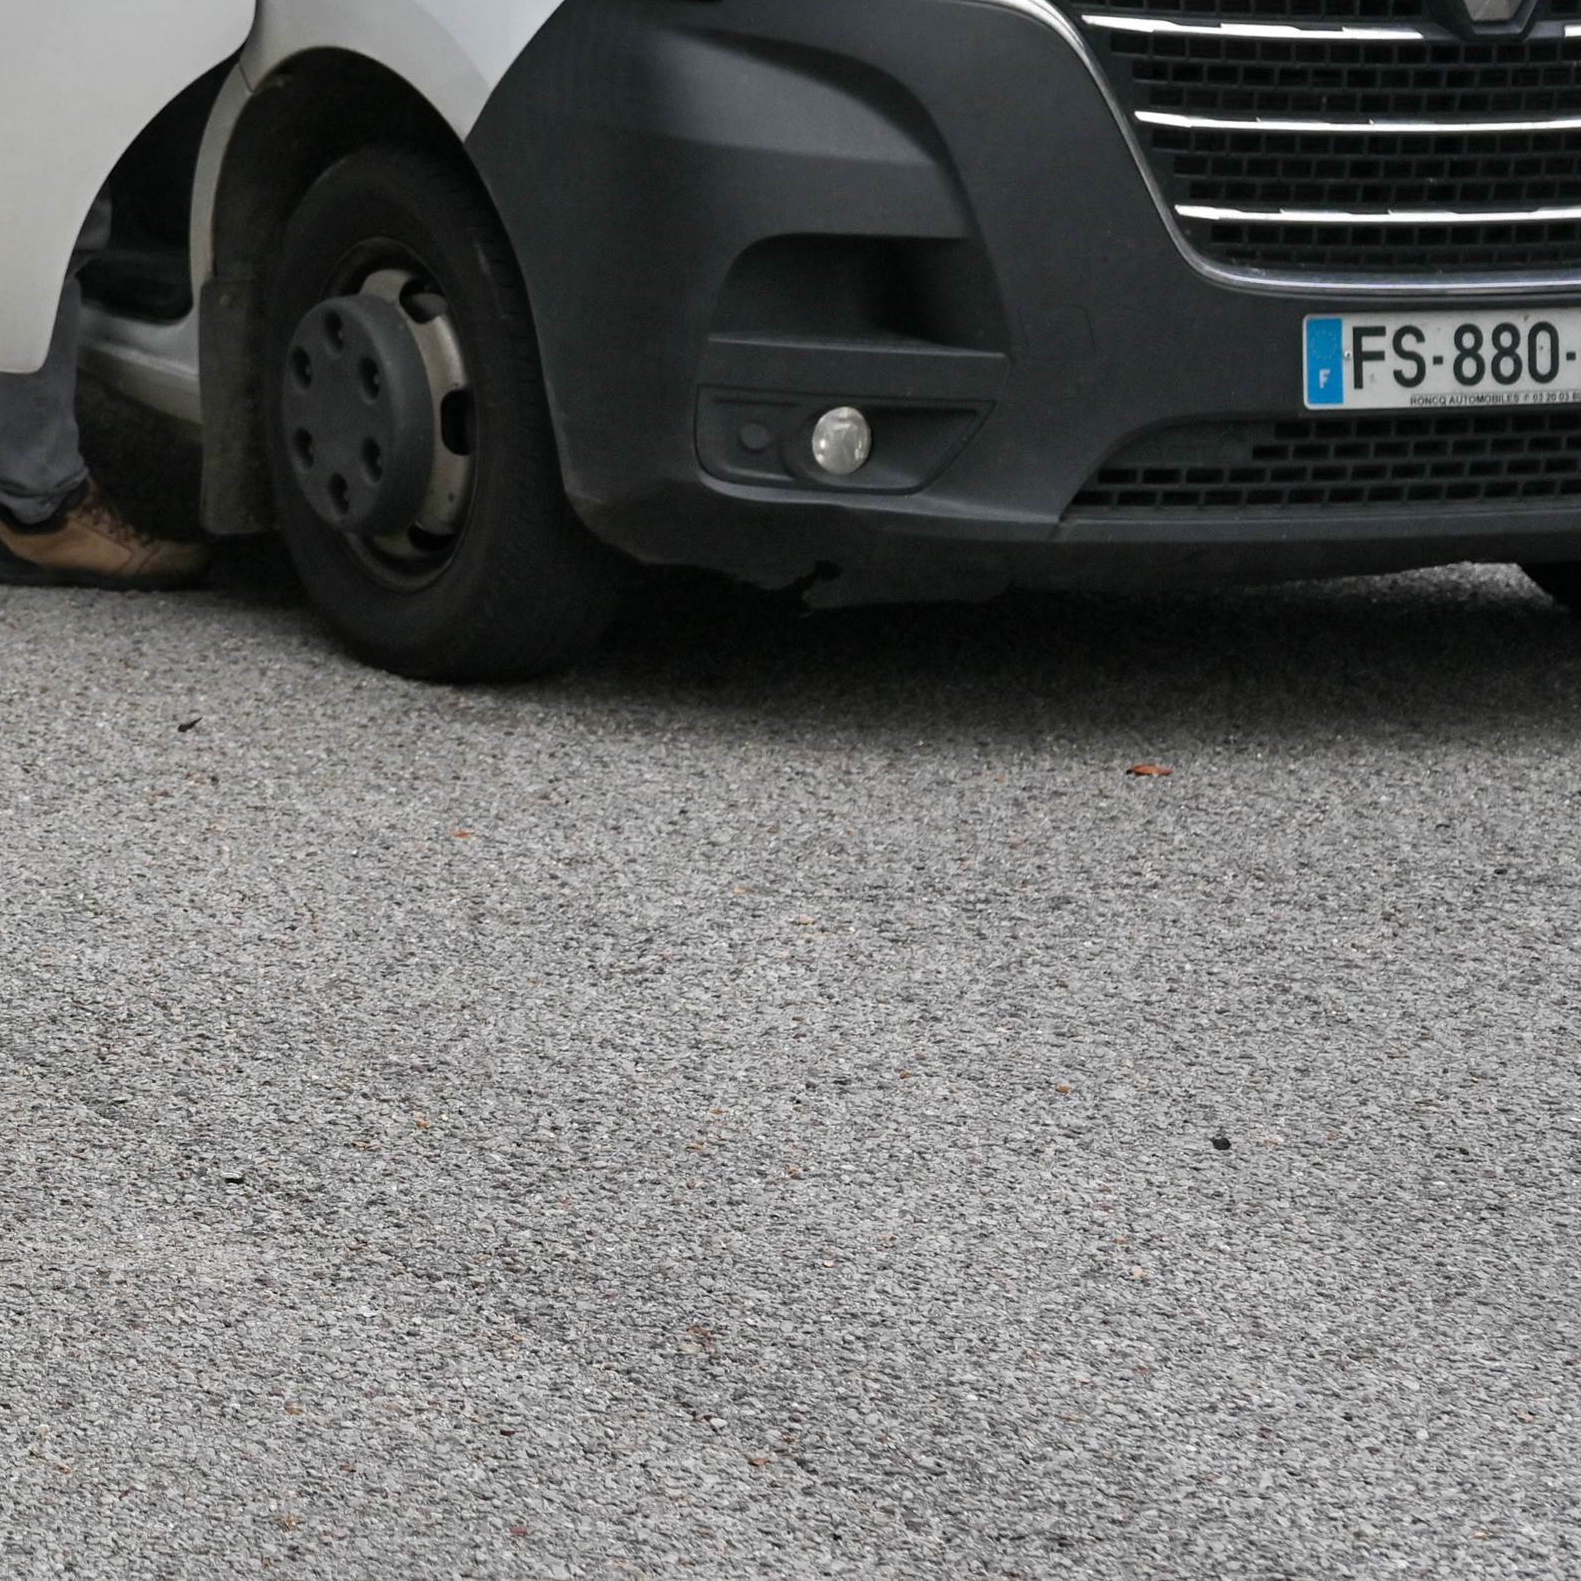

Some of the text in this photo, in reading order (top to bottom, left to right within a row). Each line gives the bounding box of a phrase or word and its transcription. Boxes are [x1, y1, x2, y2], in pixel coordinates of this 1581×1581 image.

[1318, 368, 1331, 389] F
[1410, 395, 1446, 406] RONCQ
[1545, 392, 1557, 403] 20
